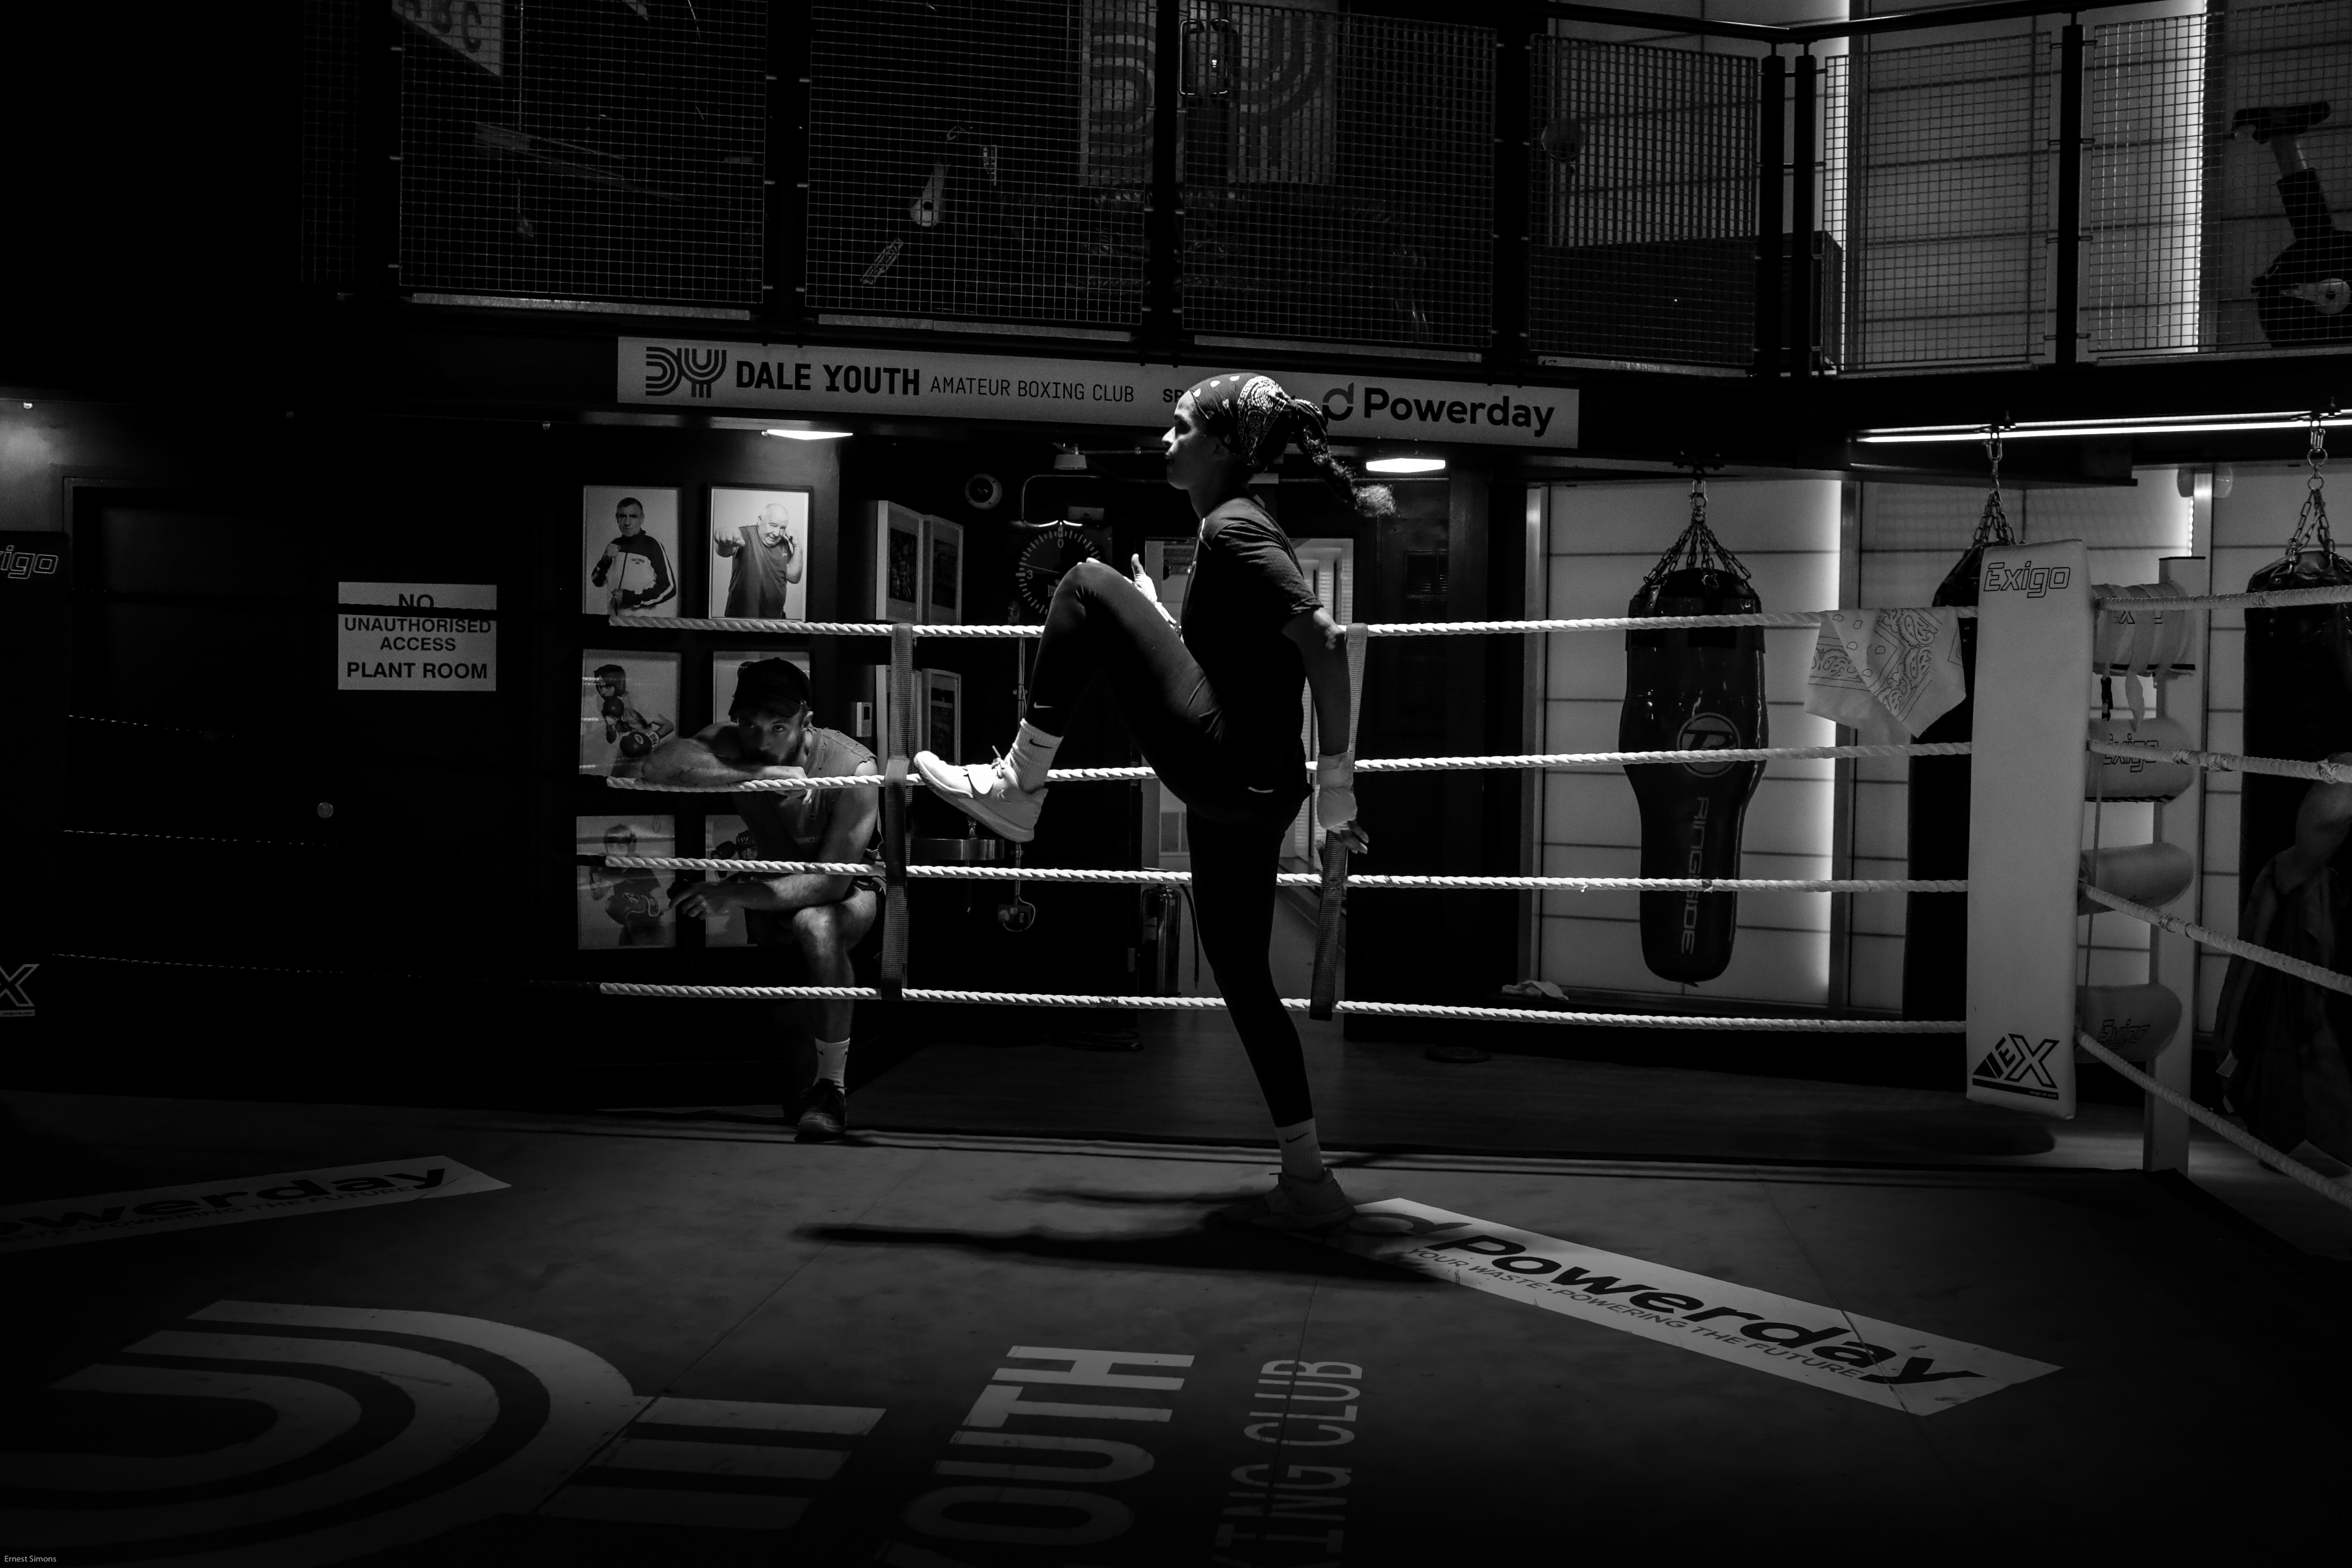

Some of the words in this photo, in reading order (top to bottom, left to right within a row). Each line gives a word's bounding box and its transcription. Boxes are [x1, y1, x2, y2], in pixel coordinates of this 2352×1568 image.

[736, 361, 811, 391] DALE
[823, 364, 919, 395] YOUTH
[931, 376, 1010, 396] AMATEUR
[1018, 380, 1085, 401] BOXING
[1092, 384, 1134, 402] CLUB
[1364, 387, 1554, 437] Powerday
[0, 545, 59, 579] igo
[1057, 539, 1064, 548] 0
[1026, 570, 1033, 579] 3
[1983, 560, 2071, 598] Exigo
[398, 594, 435, 608] NO
[345, 617, 491, 633] UNAUTHORISED
[380, 637, 456, 651] ACCESS
[347, 662, 416, 678] PLANT
[423, 663, 487, 679] ROOM
[0, 1169, 444, 1235] werday
[89, 1206, 244, 1229] POWERING
[248, 1199, 303, 1210] THE
[312, 1186, 413, 1204] FUTURE
[1408, 1248, 1469, 1268] YOUR
[1470, 1265, 1550, 1289] WASTE
[1553, 1289, 1693, 1328] POWERING
[1690, 1326, 1749, 1345] THE
[1744, 1342, 1866, 1379] FUTURE
[1424, 1234, 1988, 1384] Powerday
[1243, 1360, 1363, 1447] CLUB
[1211, 1463, 1353, 1568] ING
